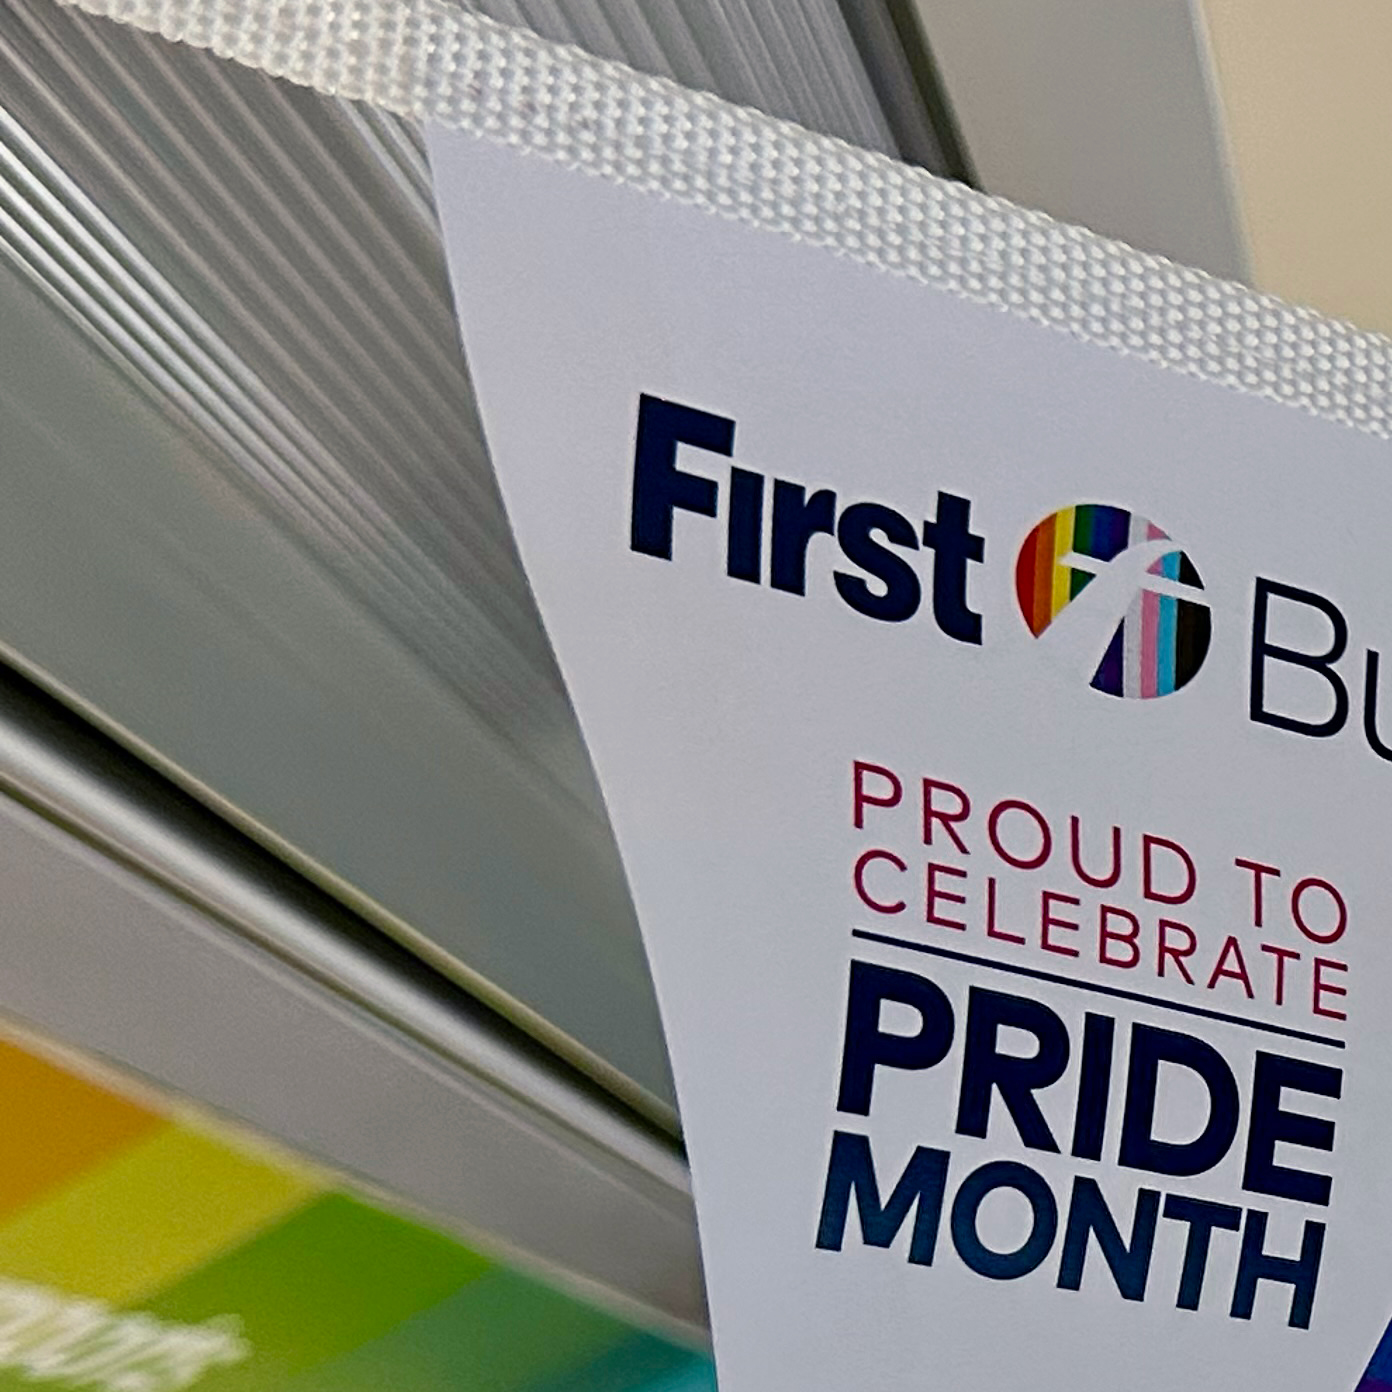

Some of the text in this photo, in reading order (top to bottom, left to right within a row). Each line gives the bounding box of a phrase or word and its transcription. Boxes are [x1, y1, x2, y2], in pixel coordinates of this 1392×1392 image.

[630, 393, 986, 646] First
[853, 761, 1349, 945] PROUD TO
[853, 850, 1349, 1022] CELEBRATE
[836, 959, 1344, 1207] PRIDE
[815, 1130, 1327, 1331] MONTH
